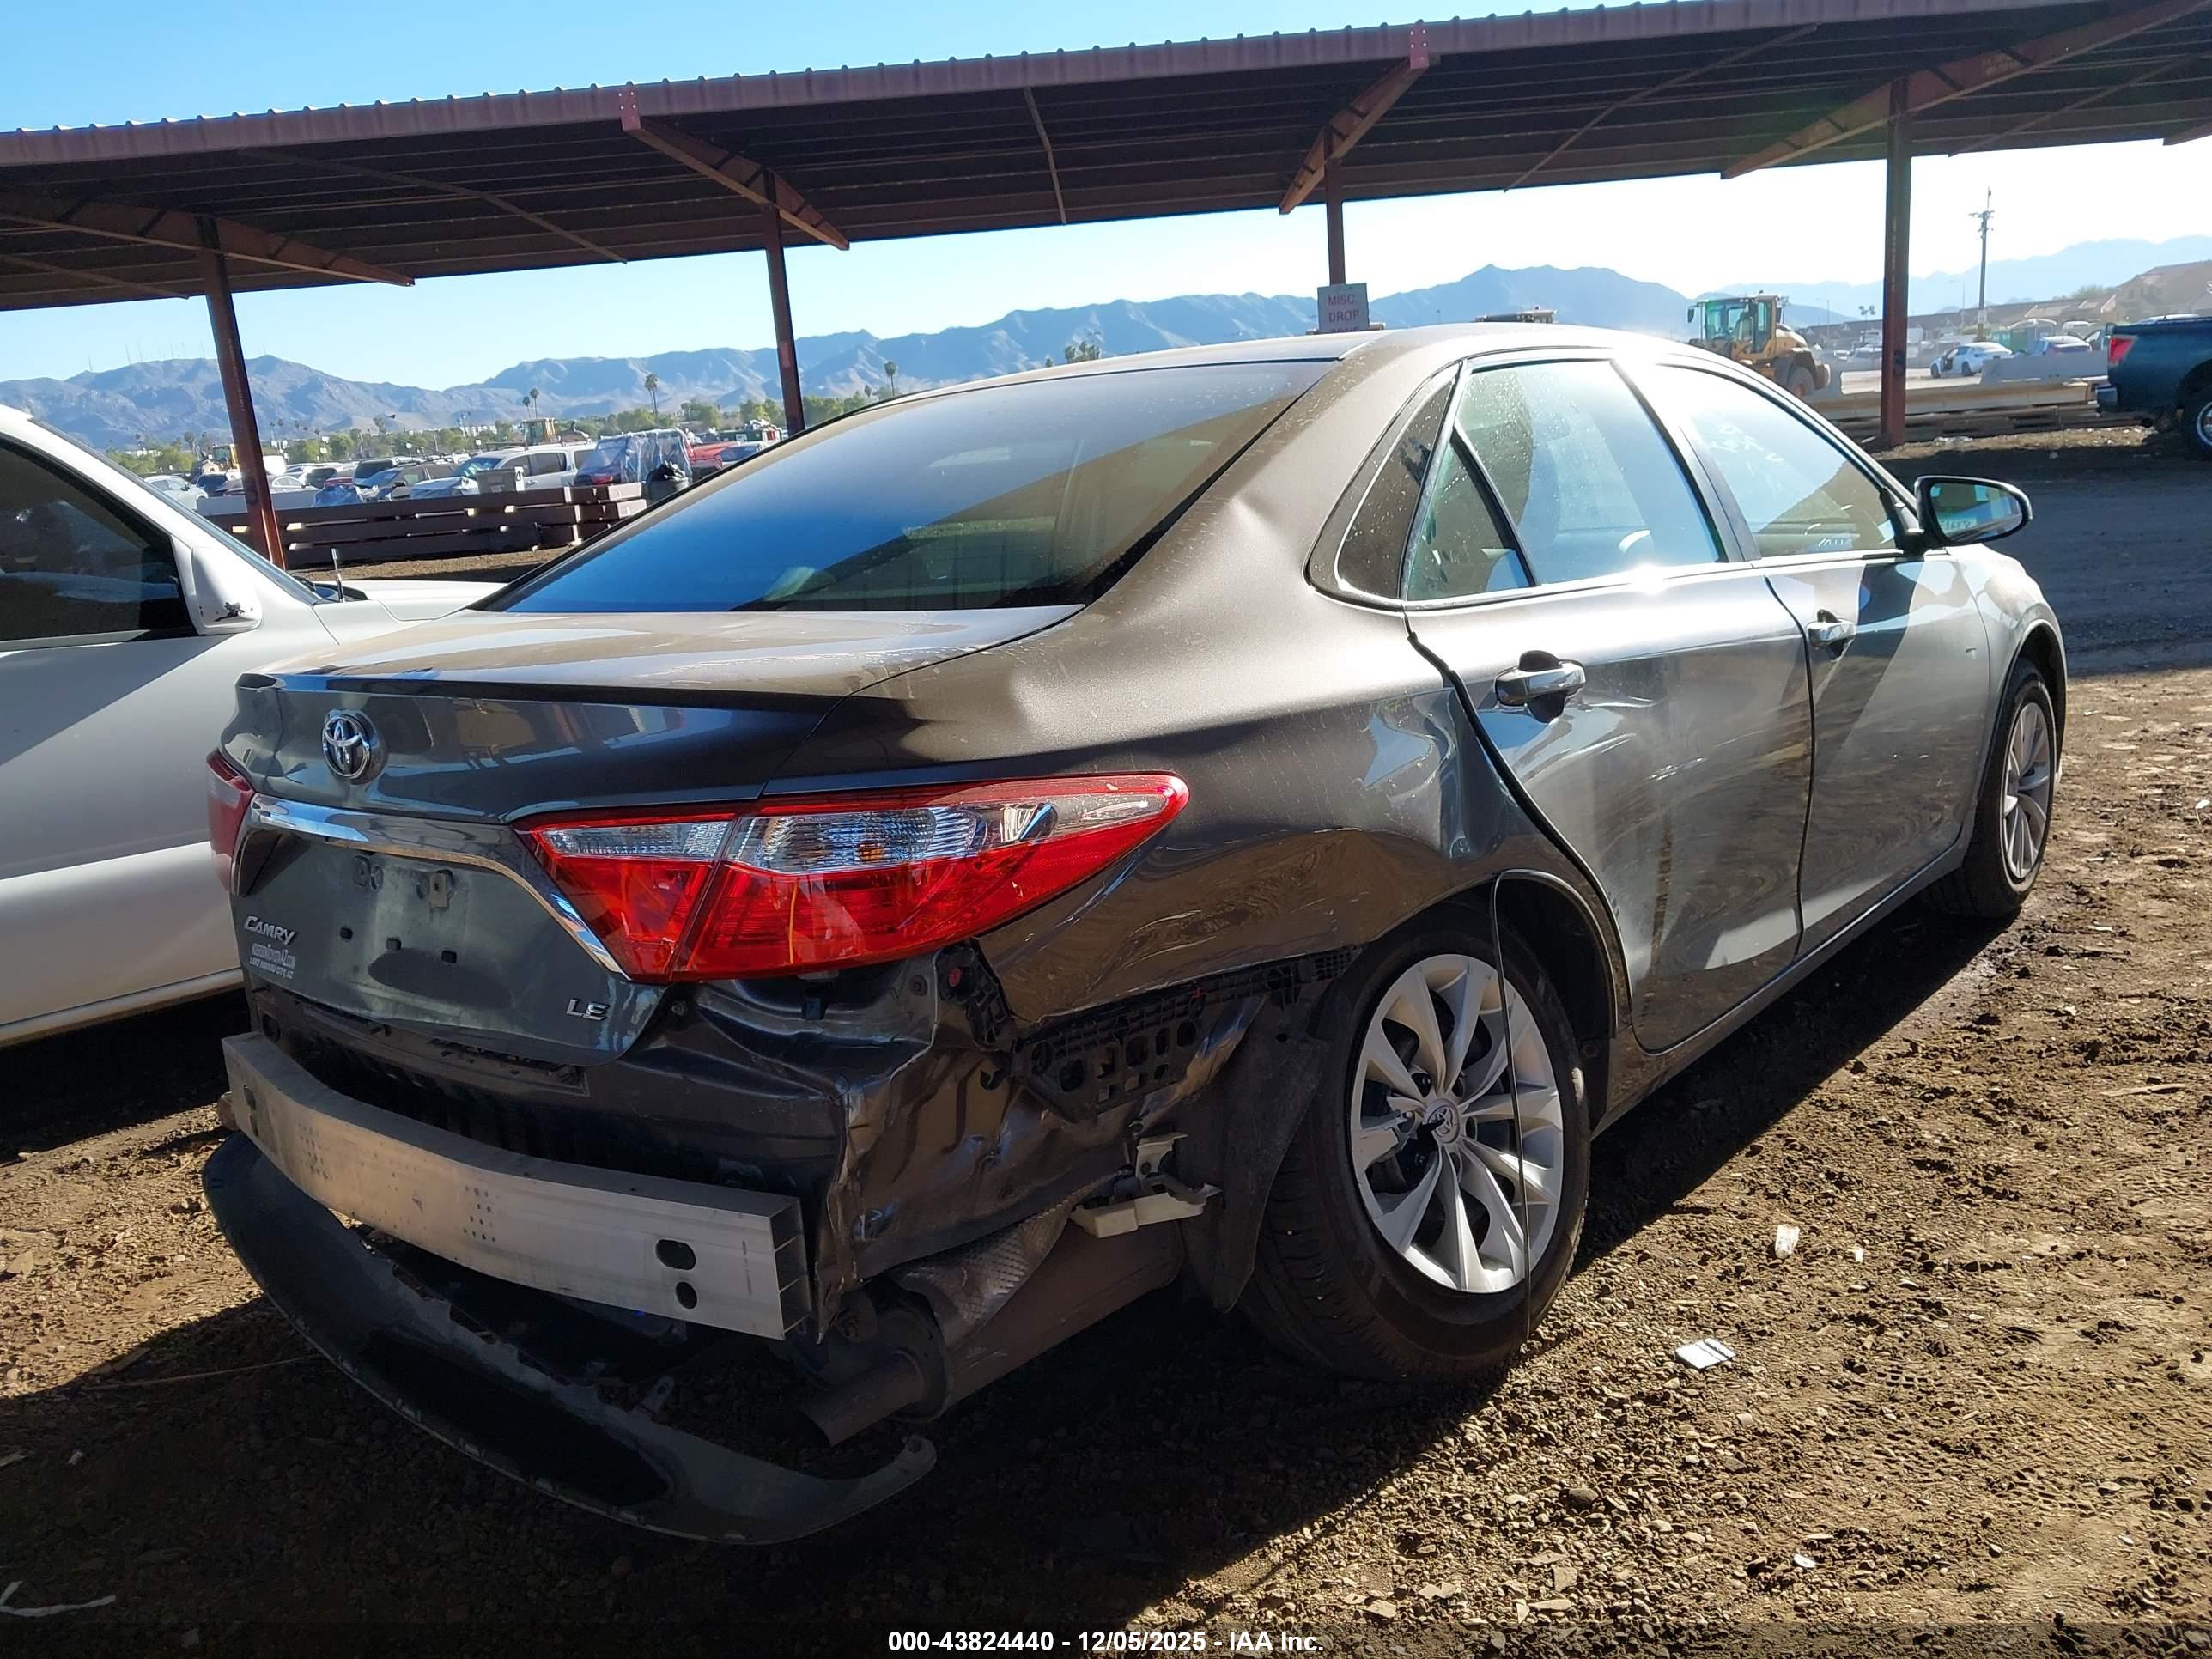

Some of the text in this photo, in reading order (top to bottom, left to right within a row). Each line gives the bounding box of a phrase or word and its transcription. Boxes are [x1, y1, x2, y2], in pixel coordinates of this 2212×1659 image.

[1328, 294, 1355, 306] MISC
[1328, 309, 1360, 323] DROP
[243, 915, 295, 945] CAMRY
[566, 999, 609, 1020] LE
